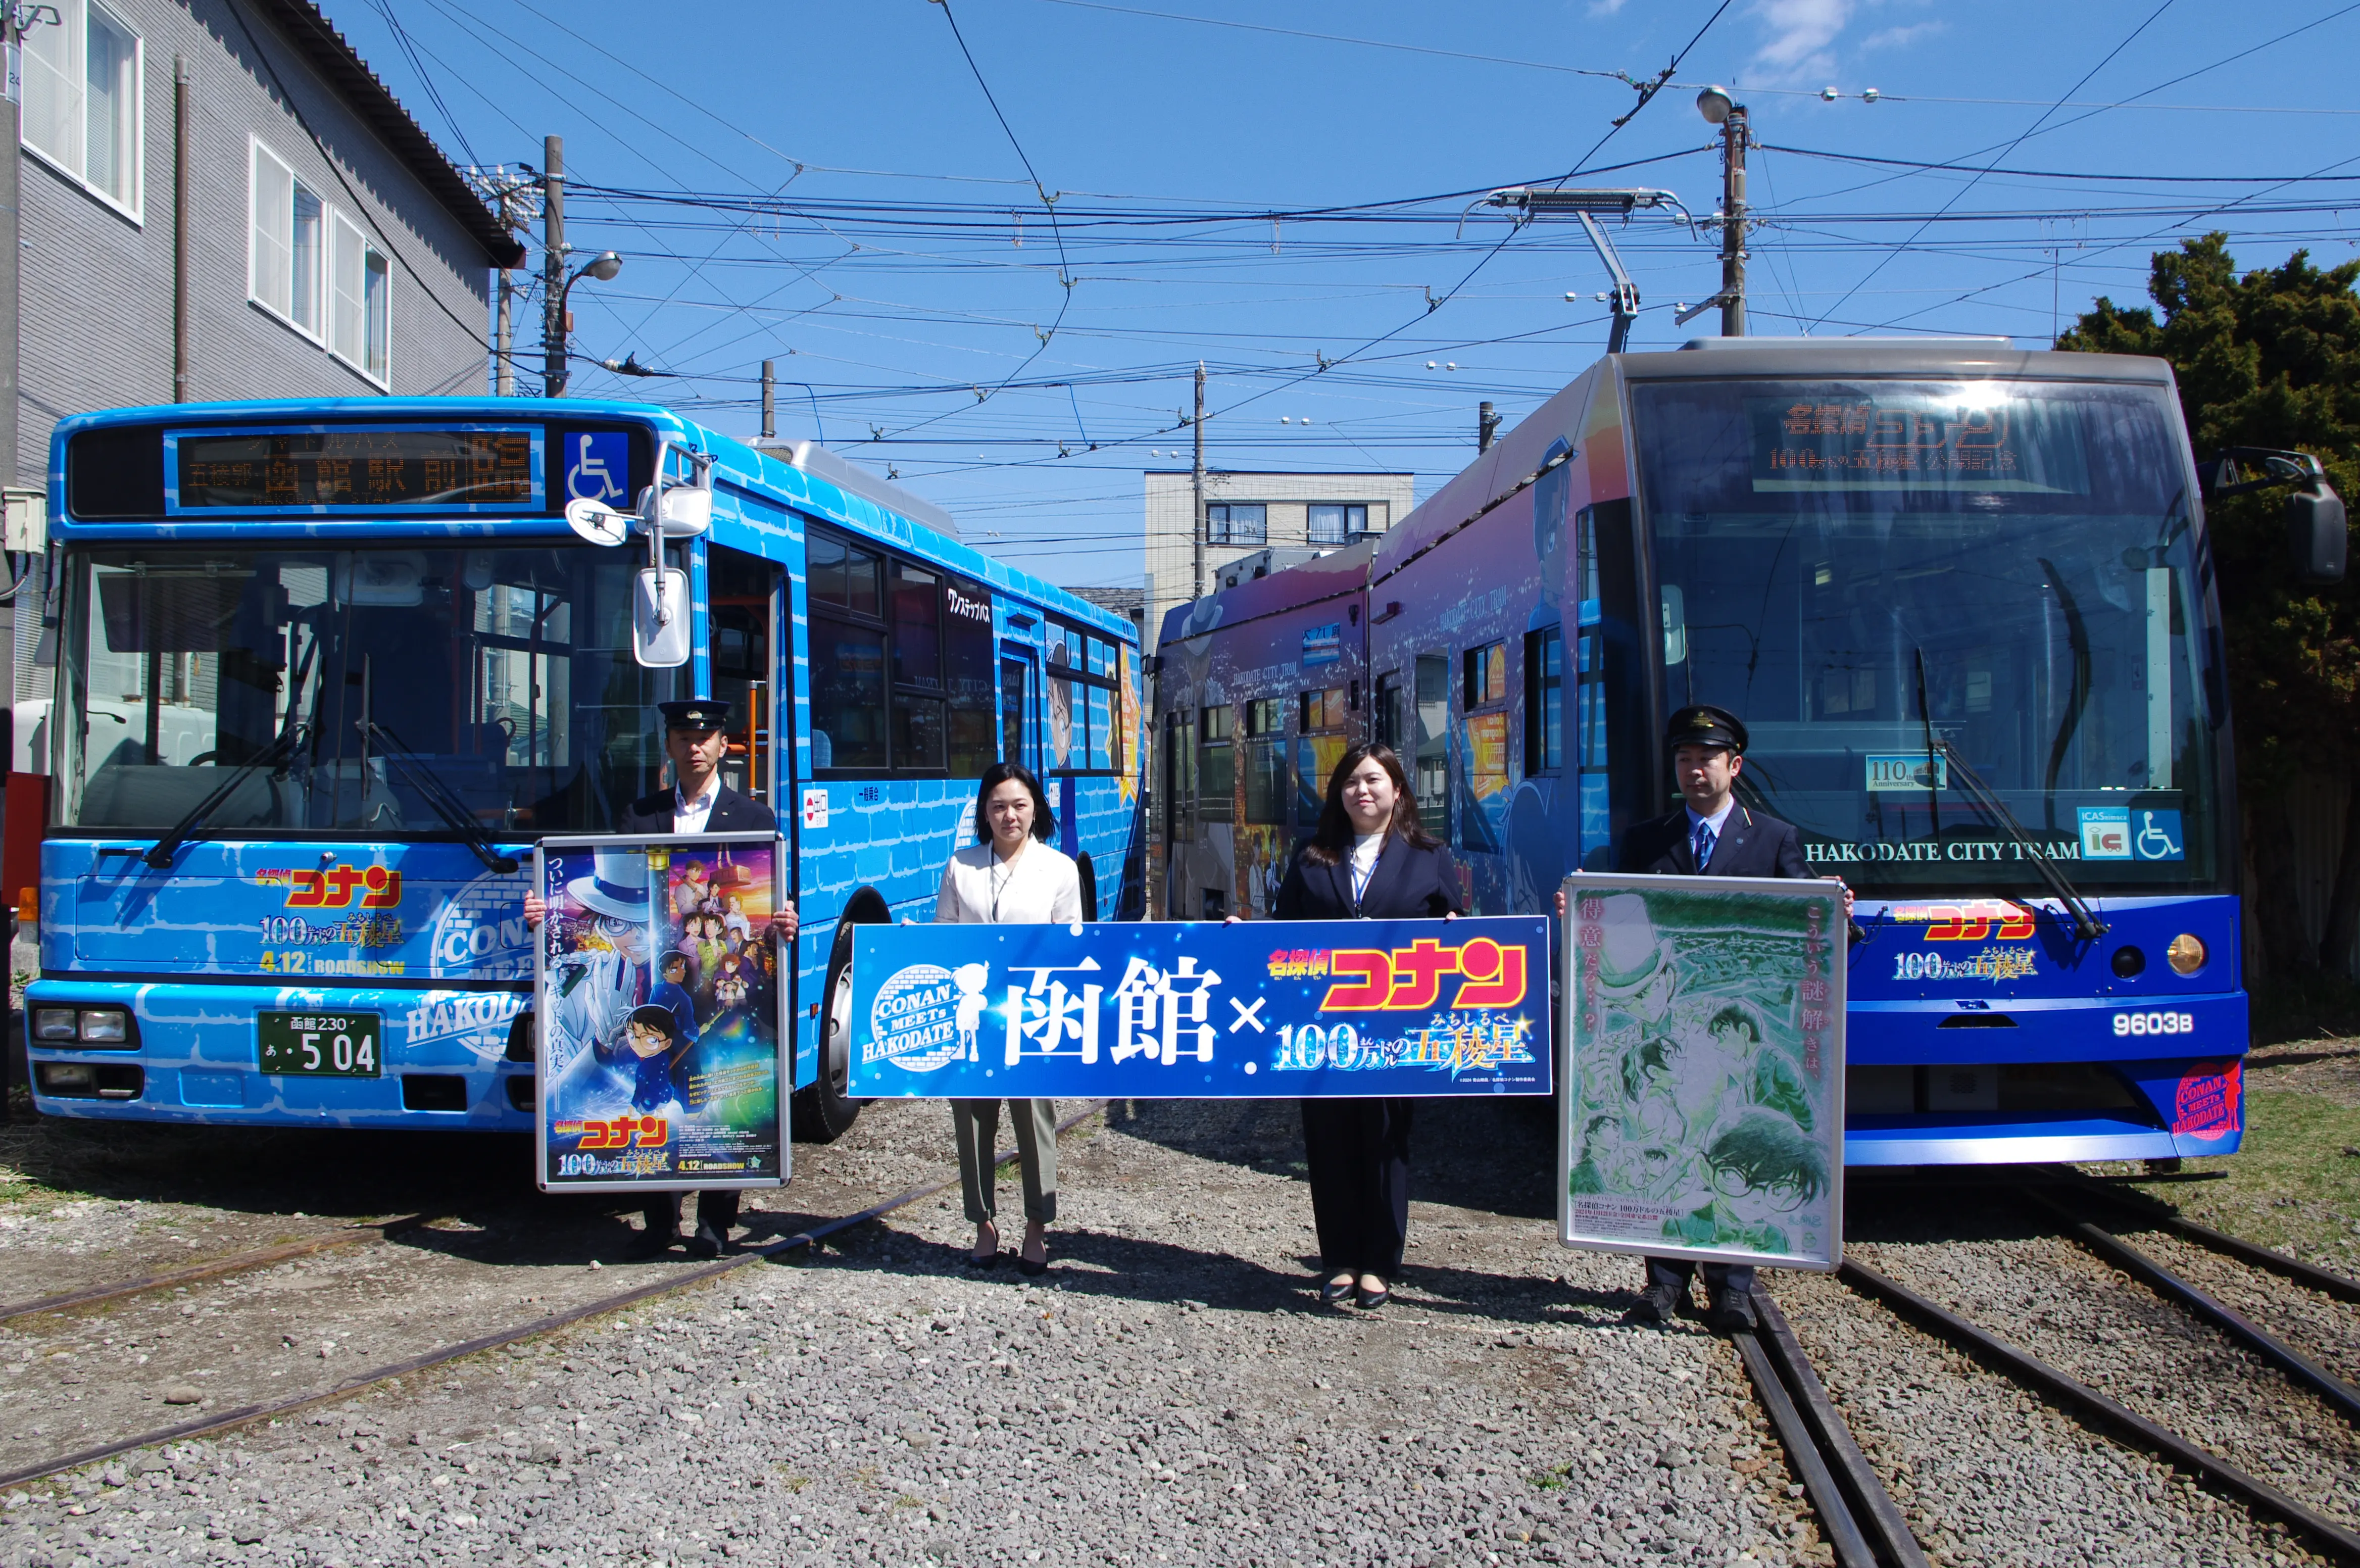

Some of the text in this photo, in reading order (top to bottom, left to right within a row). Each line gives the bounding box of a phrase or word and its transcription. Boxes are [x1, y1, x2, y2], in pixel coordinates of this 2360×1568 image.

[264, 451, 458, 492] 函館駅前
[948, 587, 990, 623] ワンステップバス
[1470, 594, 1486, 619] CITY
[1489, 584, 1506, 611] TRAM
[1233, 661, 1297, 686] HAKODATE CITY TRAM
[859, 787, 879, 801] 一般乗合
[1873, 779, 1915, 788] Anniversary
[814, 794, 827, 812] 出口
[816, 816, 826, 825] EXIT
[1804, 841, 2081, 862] HAKODATE CITY TRAM
[256, 864, 402, 909] 名探偵コナン
[444, 916, 534, 963] CON
[259, 951, 306, 973] 4.12
[313, 960, 405, 975] ROADSHOW
[1267, 938, 1527, 1011] 名探偵コナン
[878, 983, 951, 1018] CONAN
[1004, 955, 1222, 1066] 函館
[291, 1016, 347, 1031] 函館 230
[406, 993, 534, 1043] HAKOD
[891, 1008, 946, 1032] MEETs
[1431, 1011, 1509, 1026] みちしるべ
[2113, 1011, 2194, 1036] 9603B
[265, 1044, 276, 1057] あ
[862, 1020, 954, 1062] HAKODATE
[2180, 1076, 2222, 1104] CONAN
[554, 1115, 668, 1149] 名探偵コナン
[2172, 1103, 2224, 1135] HAKODATE
[678, 1160, 745, 1171] 4.12 ROADSHOW
